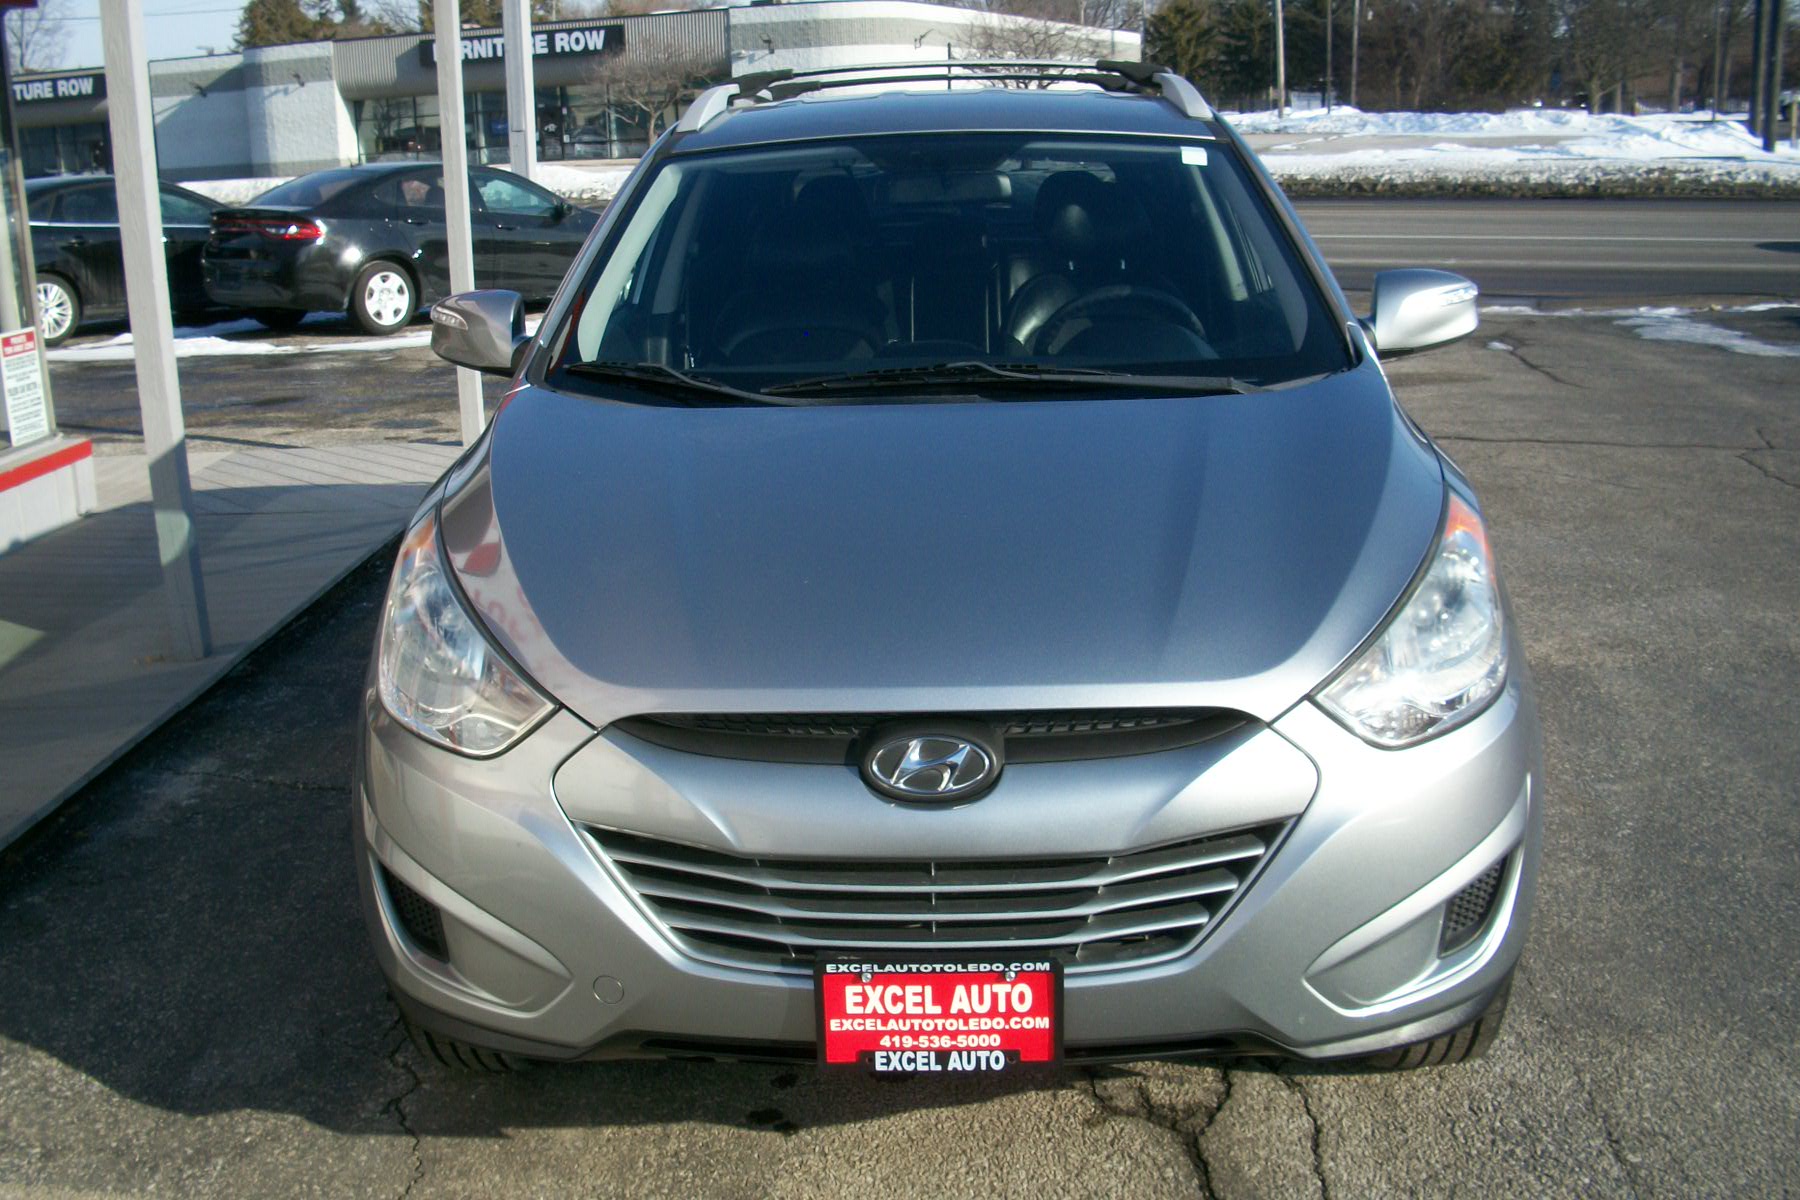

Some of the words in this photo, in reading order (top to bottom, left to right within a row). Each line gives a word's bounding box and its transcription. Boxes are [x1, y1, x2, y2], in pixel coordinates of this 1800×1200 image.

[433, 33, 549, 62] RNITE
[554, 30, 605, 53] ROW
[57, 77, 93, 97] ROW
[826, 962, 1050, 973] EXCELAUTOTOLEDO.COM
[845, 985, 941, 1014] EXCEL
[950, 983, 1033, 1014] AUTO
[830, 1017, 1050, 1031] EXCELAUTOTOLEDO.COM
[880, 1034, 1001, 1048] 419-536-5000
[875, 1051, 942, 1071] EXCEL
[947, 1050, 1005, 1071] AUTO
